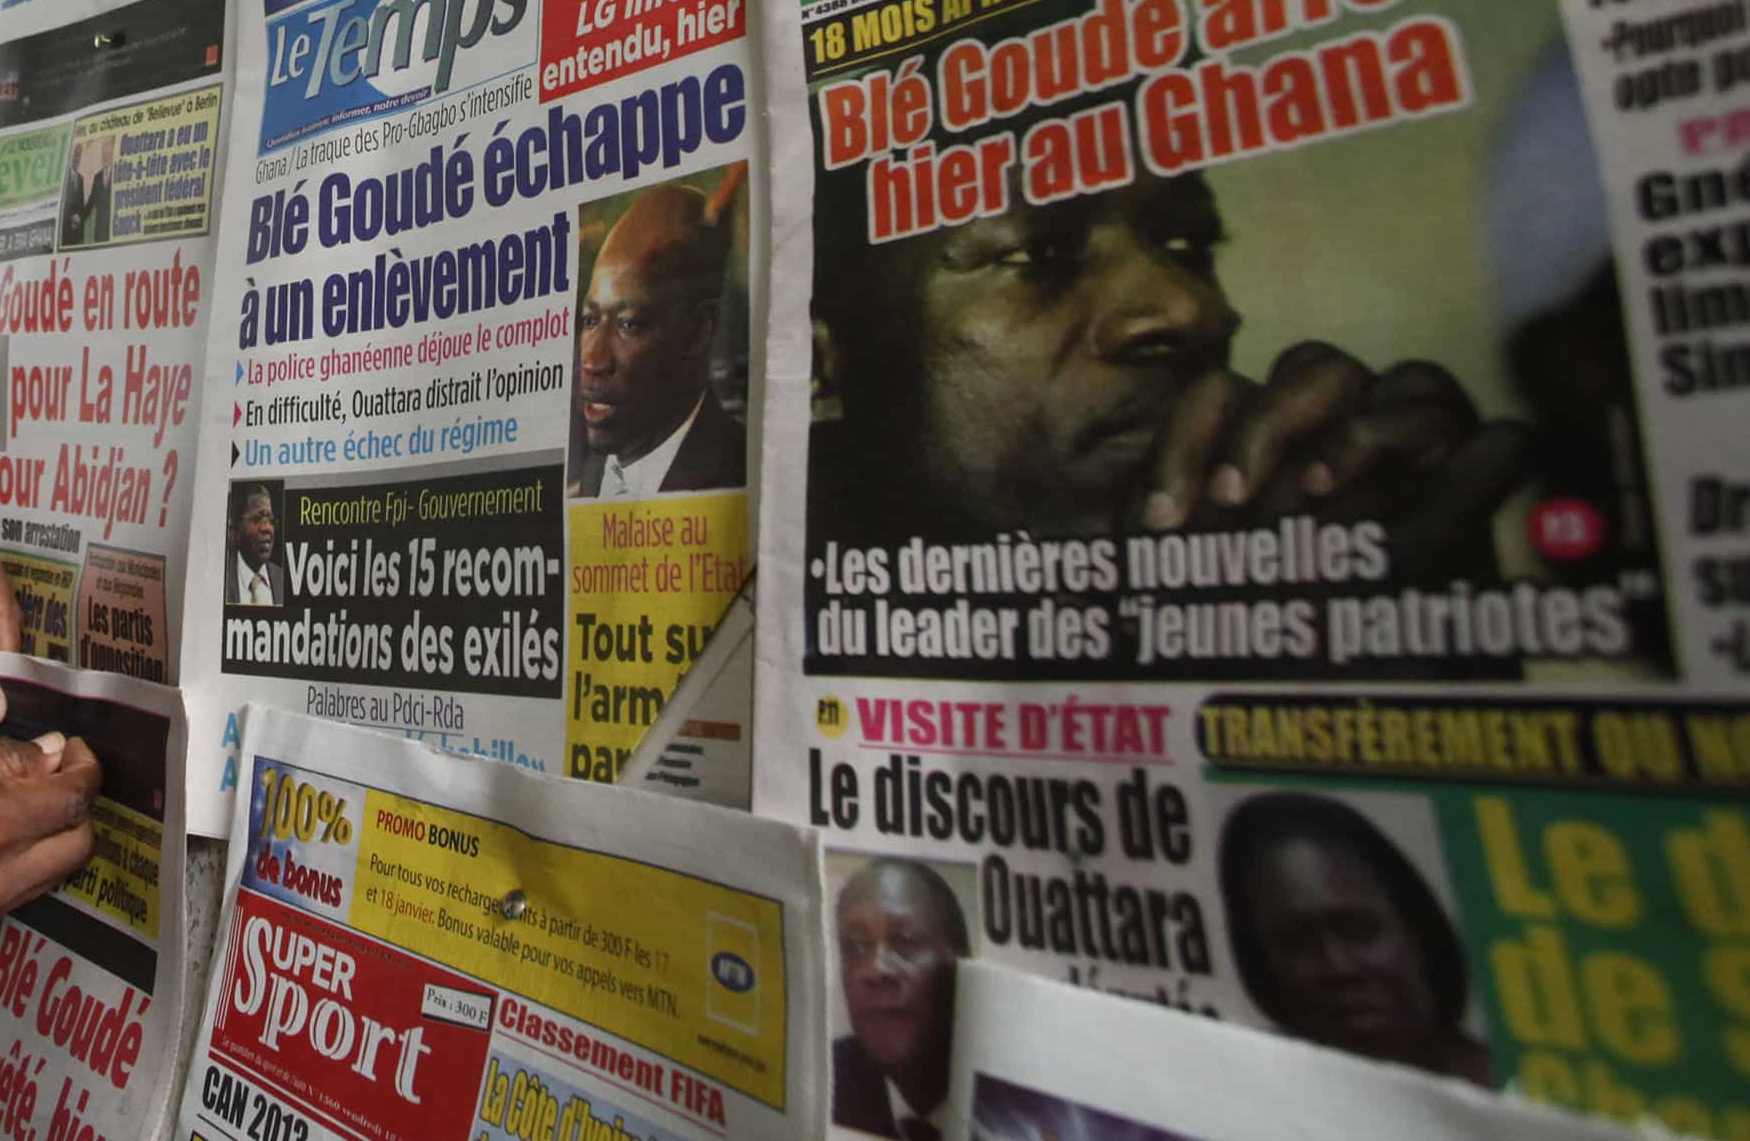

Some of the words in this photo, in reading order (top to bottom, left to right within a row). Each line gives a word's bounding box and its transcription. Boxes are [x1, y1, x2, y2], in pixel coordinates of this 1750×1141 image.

[354, 126, 380, 156] des
[382, 109, 457, 149] Pro-Gbagbo
[822, 59, 931, 167] Blé
[870, 134, 1015, 243] hier
[1024, 102, 1132, 203] au
[1140, 17, 1467, 173] Ghana
[246, 179, 310, 265] Blé
[317, 140, 475, 250] Goudé
[483, 64, 747, 210] échappe
[82, 275, 115, 332] en
[123, 250, 201, 328] route
[239, 279, 260, 350] à
[265, 270, 315, 343] un
[322, 211, 571, 339] enlèvement
[266, 352, 316, 389] police
[319, 341, 413, 379] ghanéenne
[416, 328, 473, 367] déjoue
[476, 324, 494, 353] le
[496, 307, 570, 352] complot
[11, 364, 72, 439] pour
[78, 346, 114, 425] La
[121, 344, 193, 450] Haye
[351, 384, 422, 419] Ouattara
[424, 373, 482, 410] distrait
[486, 362, 565, 405] l'opinion
[244, 440, 272, 467] Un
[276, 433, 337, 464] autre
[344, 422, 405, 459] échec
[408, 424, 435, 455] du
[439, 413, 519, 457] régime
[50, 442, 152, 541] Abidjan
[299, 493, 382, 527] Rencontre
[418, 479, 544, 522] Gouvernement
[24, 521, 82, 554] arrestation
[601, 511, 672, 549] Malaise
[677, 517, 709, 548] au
[285, 539, 360, 597] Voici
[364, 538, 401, 597] les
[406, 538, 437, 597] 15
[571, 561, 650, 595] sommet
[655, 557, 683, 593] de
[897, 531, 1118, 595] dernières
[111, 601, 154, 649] partis
[225, 607, 392, 674] mandations
[400, 609, 454, 675] des
[463, 606, 560, 682] exilés
[575, 611, 653, 659] Tout
[817, 600, 866, 656] du
[875, 599, 1019, 658] leader
[1027, 599, 1110, 659] des
[366, 696, 390, 721] au
[392, 691, 465, 732] Pdci-Rda
[855, 697, 1007, 749] VISITE
[260, 766, 352, 846] 100%
[376, 810, 426, 842] PROMO
[427, 825, 480, 859] BONUS
[808, 748, 860, 829] Le
[874, 754, 1106, 859] discours
[1116, 767, 1193, 866] de
[437, 908, 474, 938] Bonus
[476, 923, 520, 957] valable
[983, 853, 1213, 976] Ouattara
[37, 956, 151, 1089] Goudé
[454, 999, 477, 1021] 300
[499, 998, 665, 1097] Classement
[669, 1068, 727, 1128] FIFA
[202, 1065, 248, 1125] CAN
